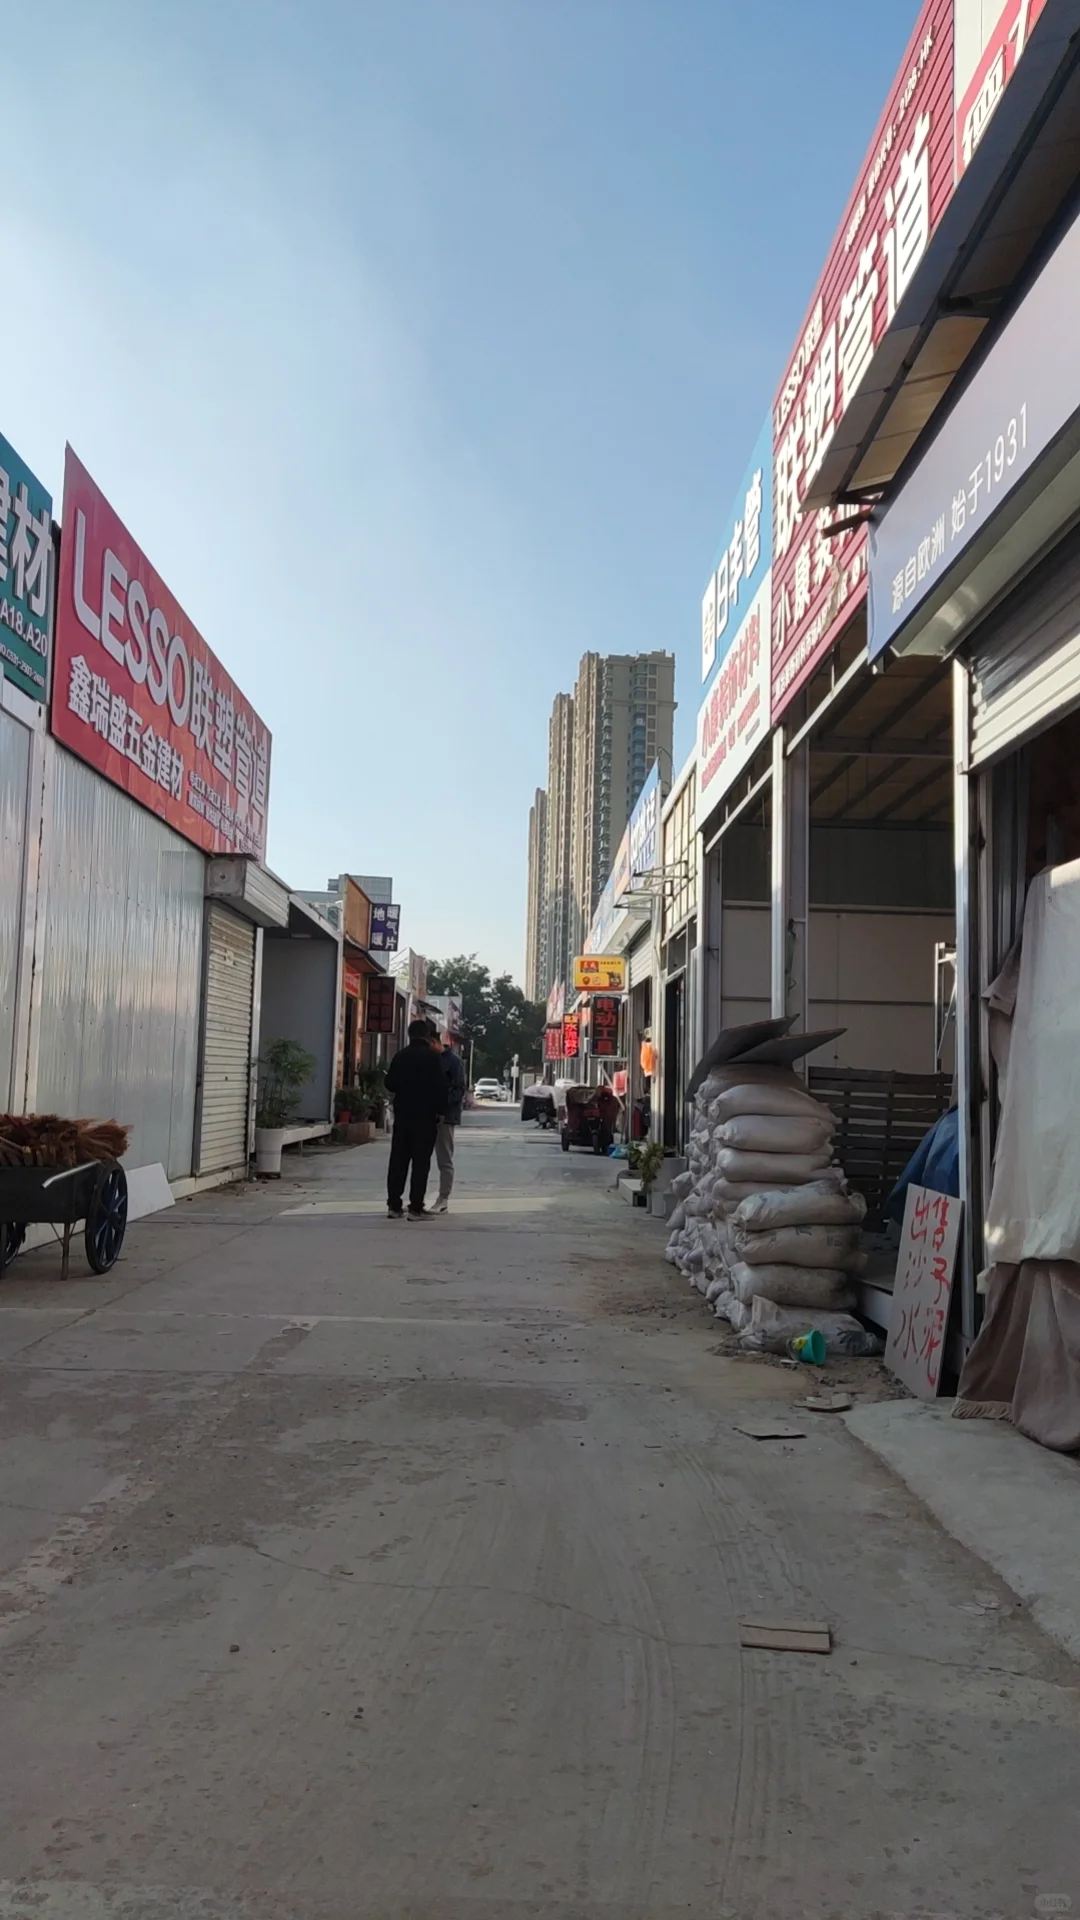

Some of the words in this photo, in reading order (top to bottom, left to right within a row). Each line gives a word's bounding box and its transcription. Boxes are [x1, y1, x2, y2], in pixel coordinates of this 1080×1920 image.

[892, 513, 945, 614] 源自欧洲
[951, 402, 1027, 541] 始于1931
[73, 507, 192, 728] LESSO
[189, 655, 267, 818] 联塑管道
[68, 654, 184, 801] 鑫瑞盛五金建材
[371, 907, 386, 946] 地暖
[384, 905, 399, 950] 暖气片
[596, 998, 617, 1053] 电动工具
